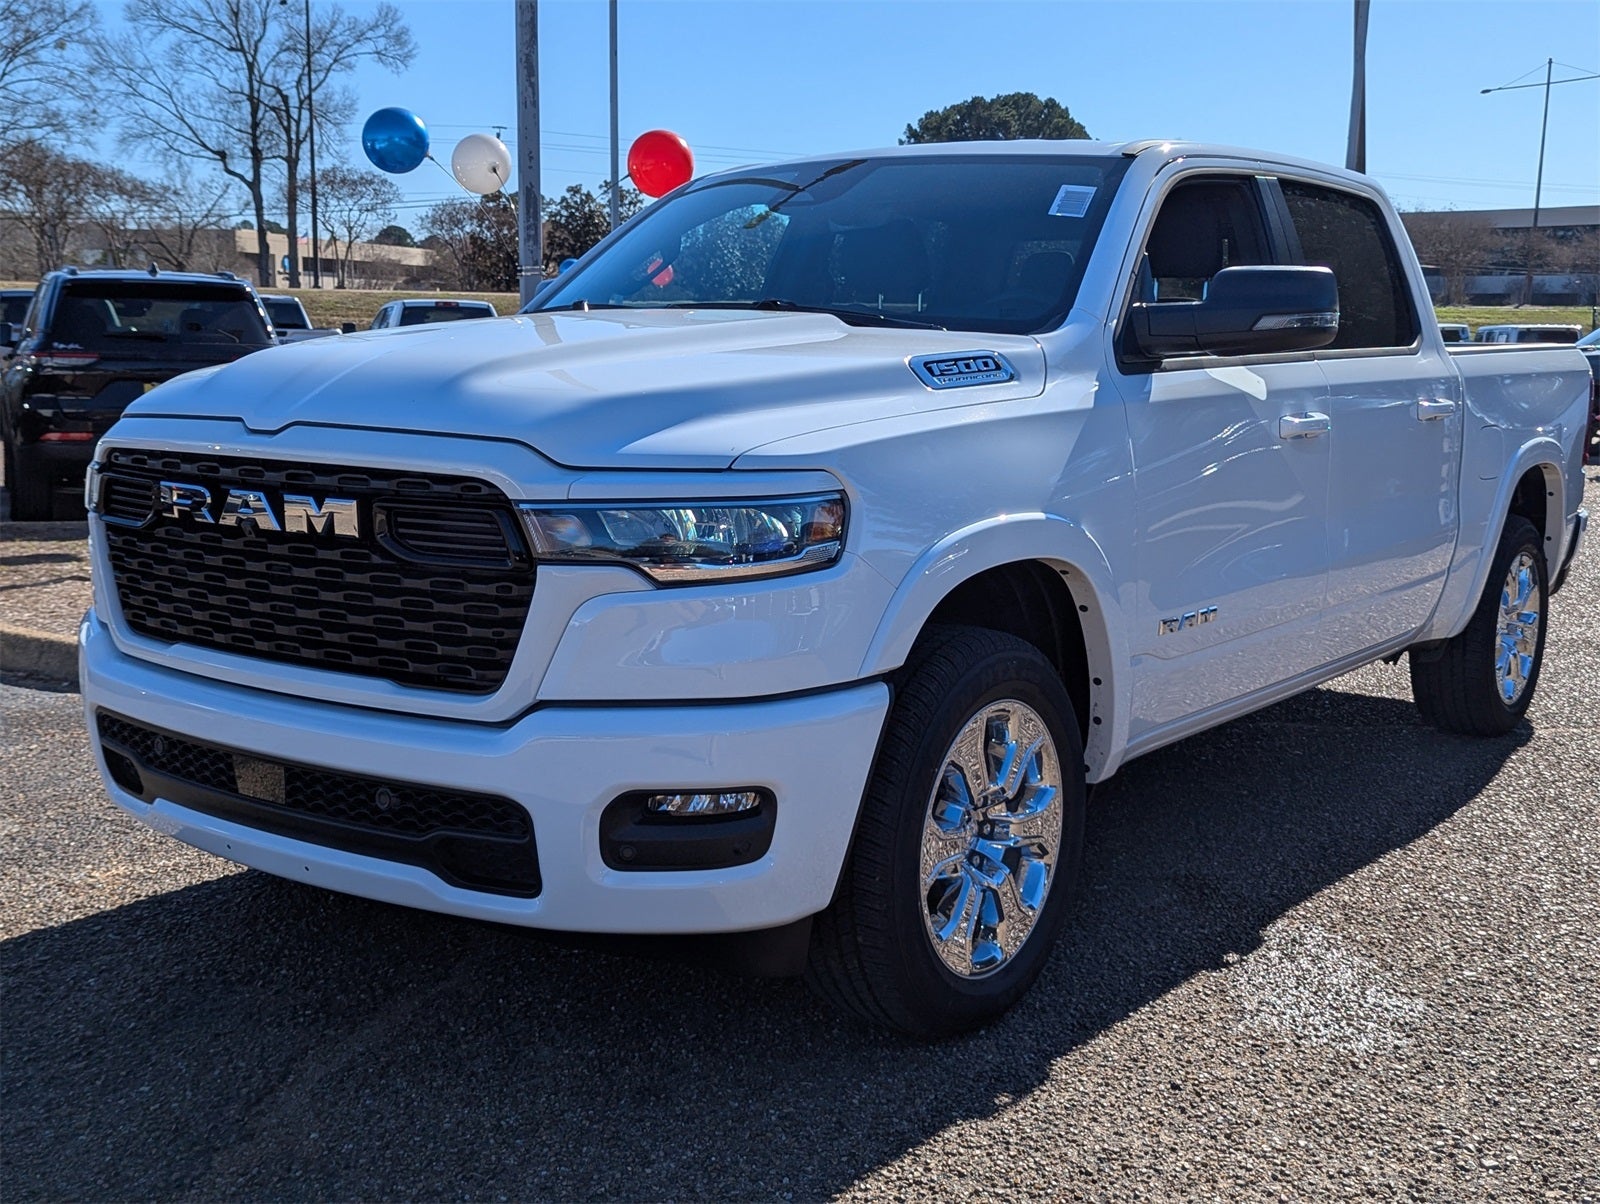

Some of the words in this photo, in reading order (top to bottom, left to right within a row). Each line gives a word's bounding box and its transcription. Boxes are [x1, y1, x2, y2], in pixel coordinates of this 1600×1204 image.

[926, 358, 996, 376] 1500
[160, 481, 360, 538] RAM
[1158, 605, 1218, 636] RAM
